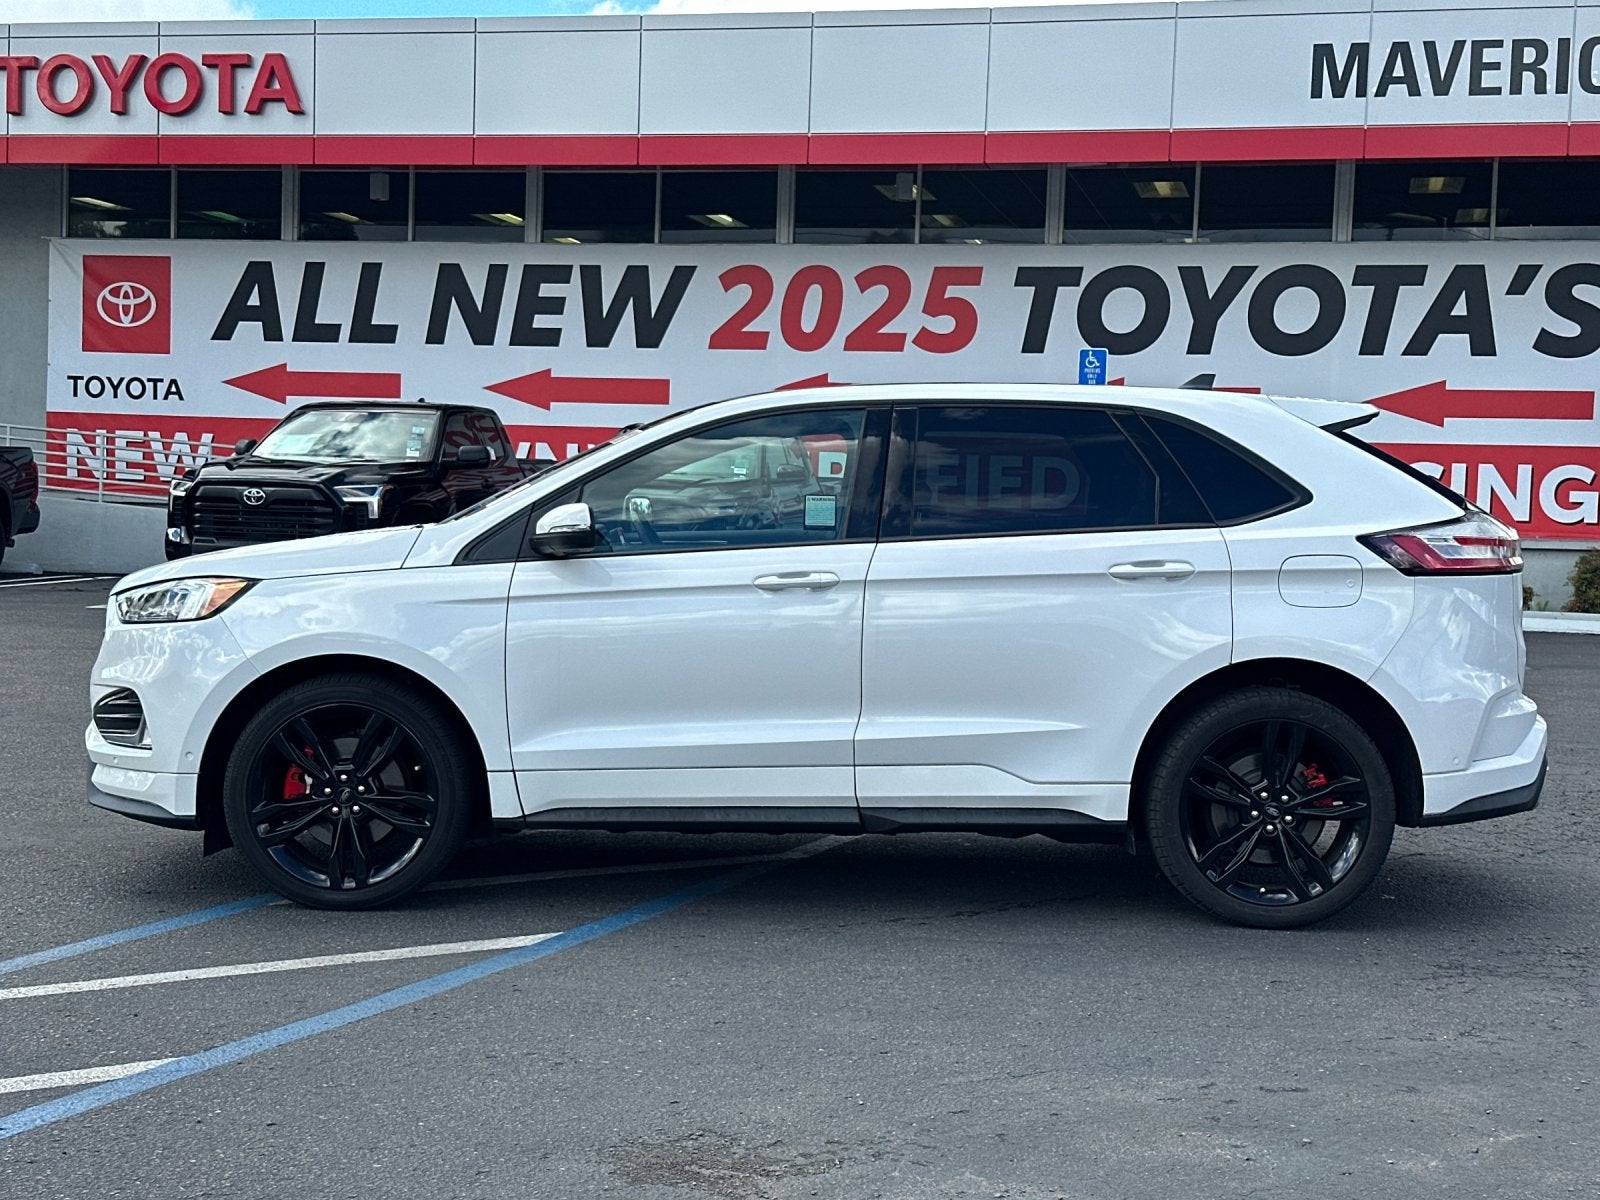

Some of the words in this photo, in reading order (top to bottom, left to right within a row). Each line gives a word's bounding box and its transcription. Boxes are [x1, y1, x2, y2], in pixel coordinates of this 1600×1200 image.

[0, 53, 304, 116] TOYOTA
[210, 261, 399, 344] ALL
[425, 263, 697, 348] NEW
[708, 264, 984, 353] 2025
[1014, 262, 1600, 358] TOYOTA'S
[67, 376, 184, 401] TOYOTA
[66, 428, 213, 481] NEW
